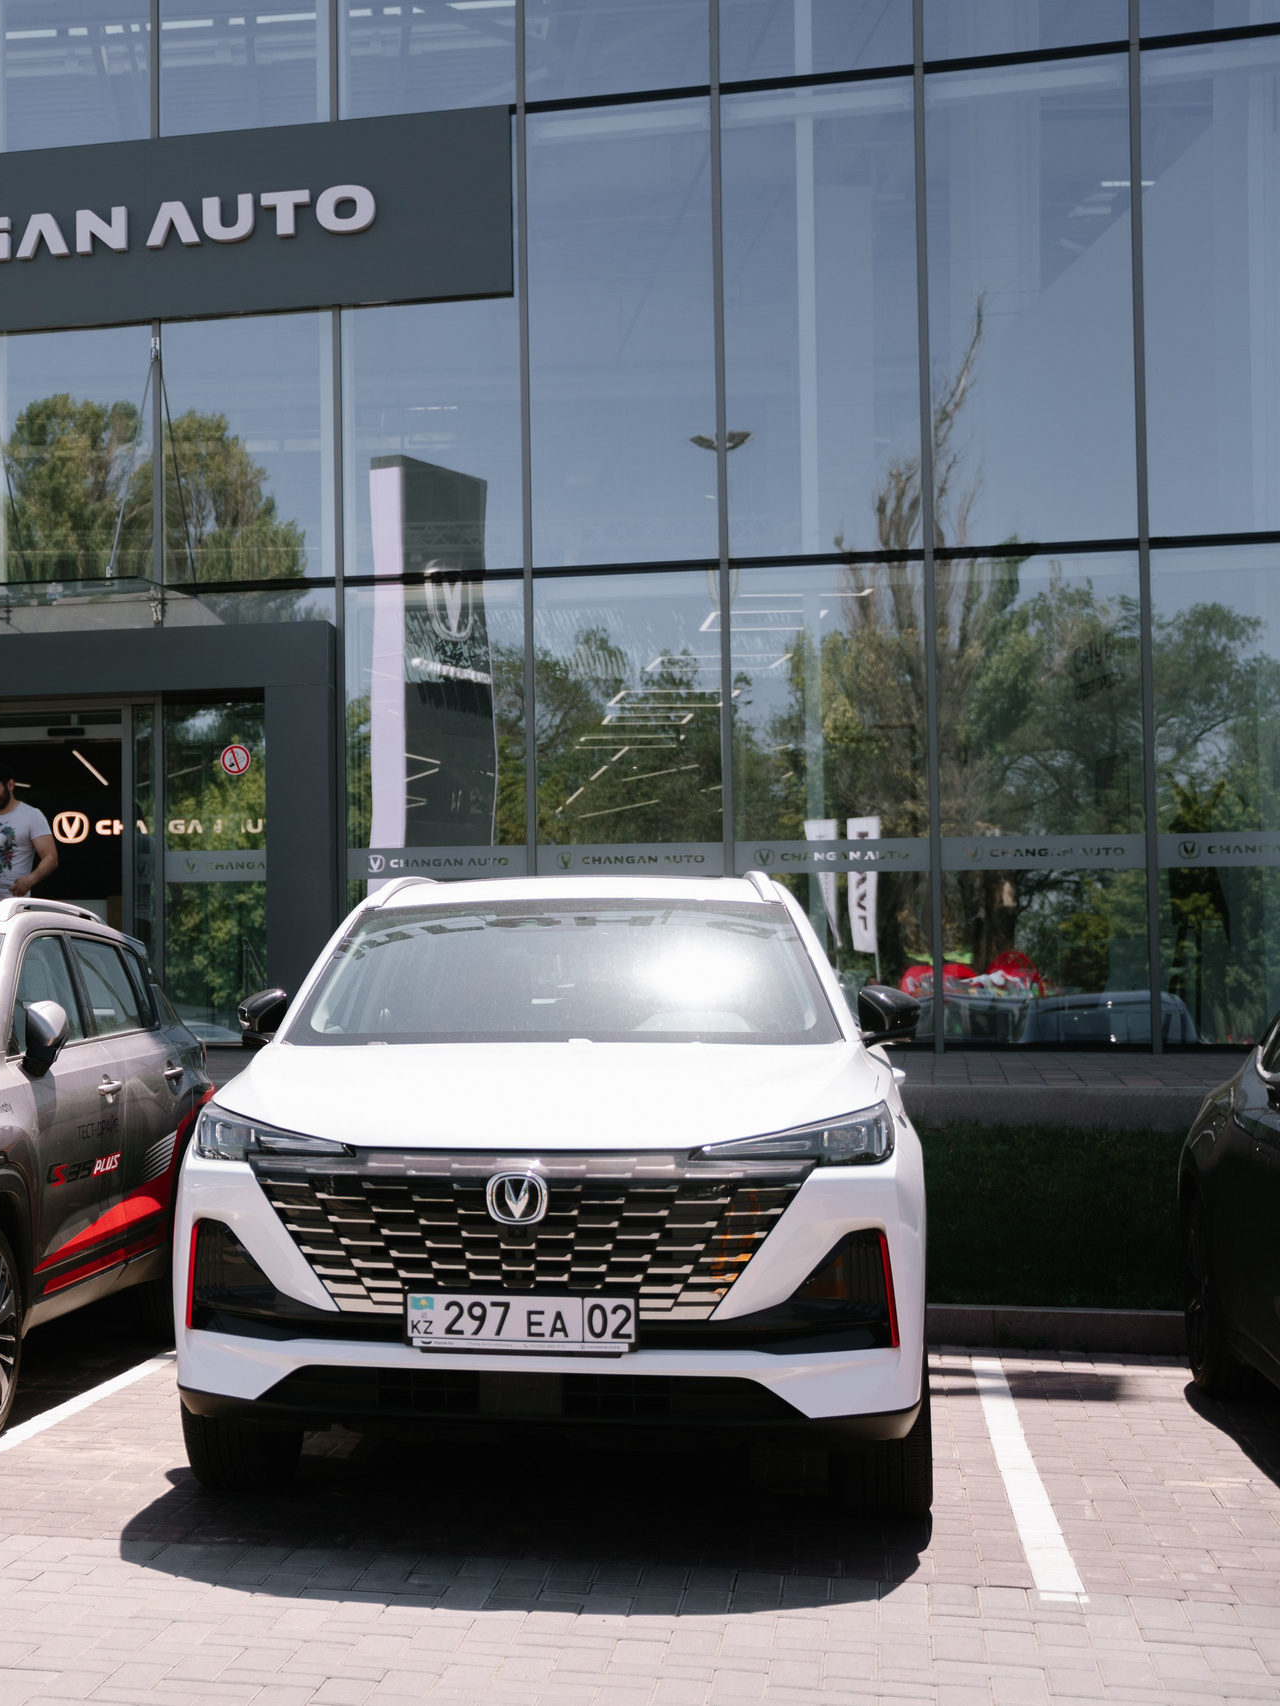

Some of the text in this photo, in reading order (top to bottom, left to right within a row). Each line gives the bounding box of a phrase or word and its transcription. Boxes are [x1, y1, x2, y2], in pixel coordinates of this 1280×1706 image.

[146, 184, 377, 251] AUTO
[581, 854, 705, 865] CHANGAN AUTO
[780, 850, 909, 861] CHANGAN AUTO
[989, 847, 1126, 858] CHANGAN AUTO
[389, 857, 509, 868] CHANGAN AUTO
[77, 1115, 120, 1140] ТЕСТ-ДРАЙВ
[45, 1153, 121, 1188] CS35 PLUS
[410, 1300, 632, 1341] KZ 297 EA 02
